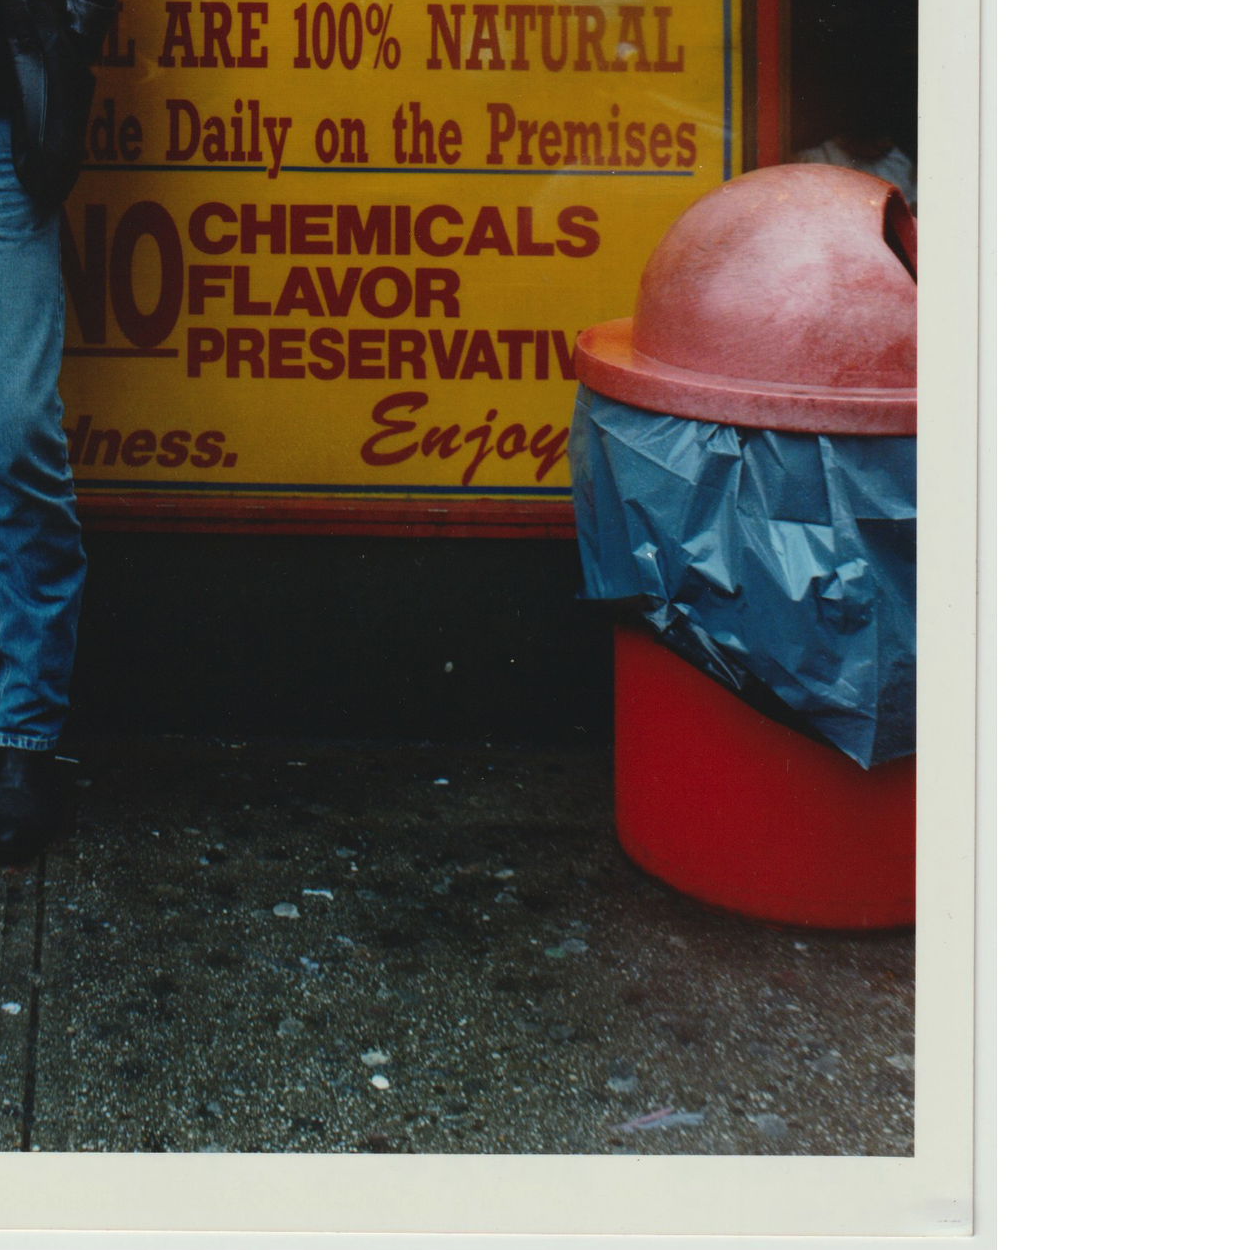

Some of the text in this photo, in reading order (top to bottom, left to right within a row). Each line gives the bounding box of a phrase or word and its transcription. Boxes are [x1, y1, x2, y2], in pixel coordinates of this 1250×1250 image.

[158, 1, 269, 68] ARE
[293, 1, 401, 69] 100%
[426, 3, 684, 73] NATURAL
[165, 98, 292, 179] Daily
[314, 114, 370, 164] on
[392, 101, 464, 166] the
[486, 102, 698, 168] Premises
[62, 200, 602, 350] NO CHEMICALS
[187, 264, 461, 318] FLAVOR
[187, 328, 583, 381] PRESERVATIV
[360, 391, 570, 486] Enjoy
